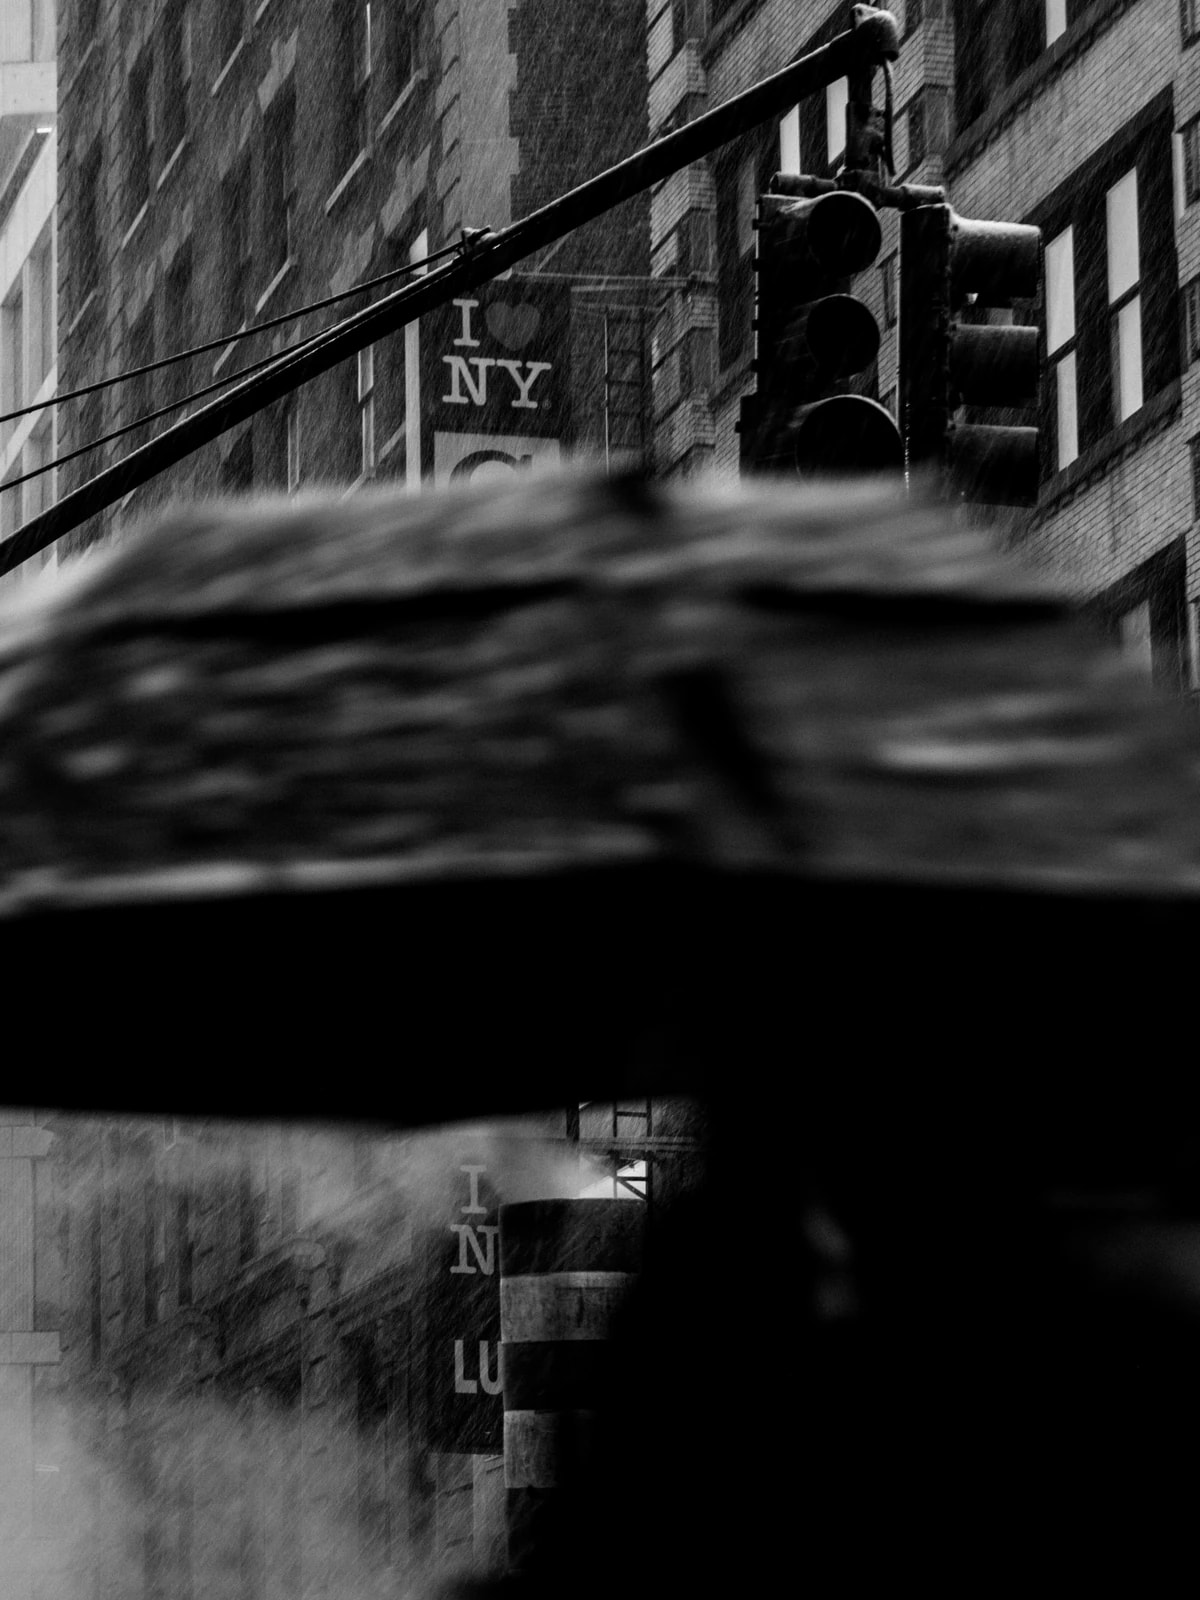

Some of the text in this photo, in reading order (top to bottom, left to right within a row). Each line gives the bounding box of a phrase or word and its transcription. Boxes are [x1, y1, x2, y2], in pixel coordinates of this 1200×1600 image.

[452, 298, 481, 348] I
[442, 355, 552, 409] NY
[460, 1164, 488, 1215] I
